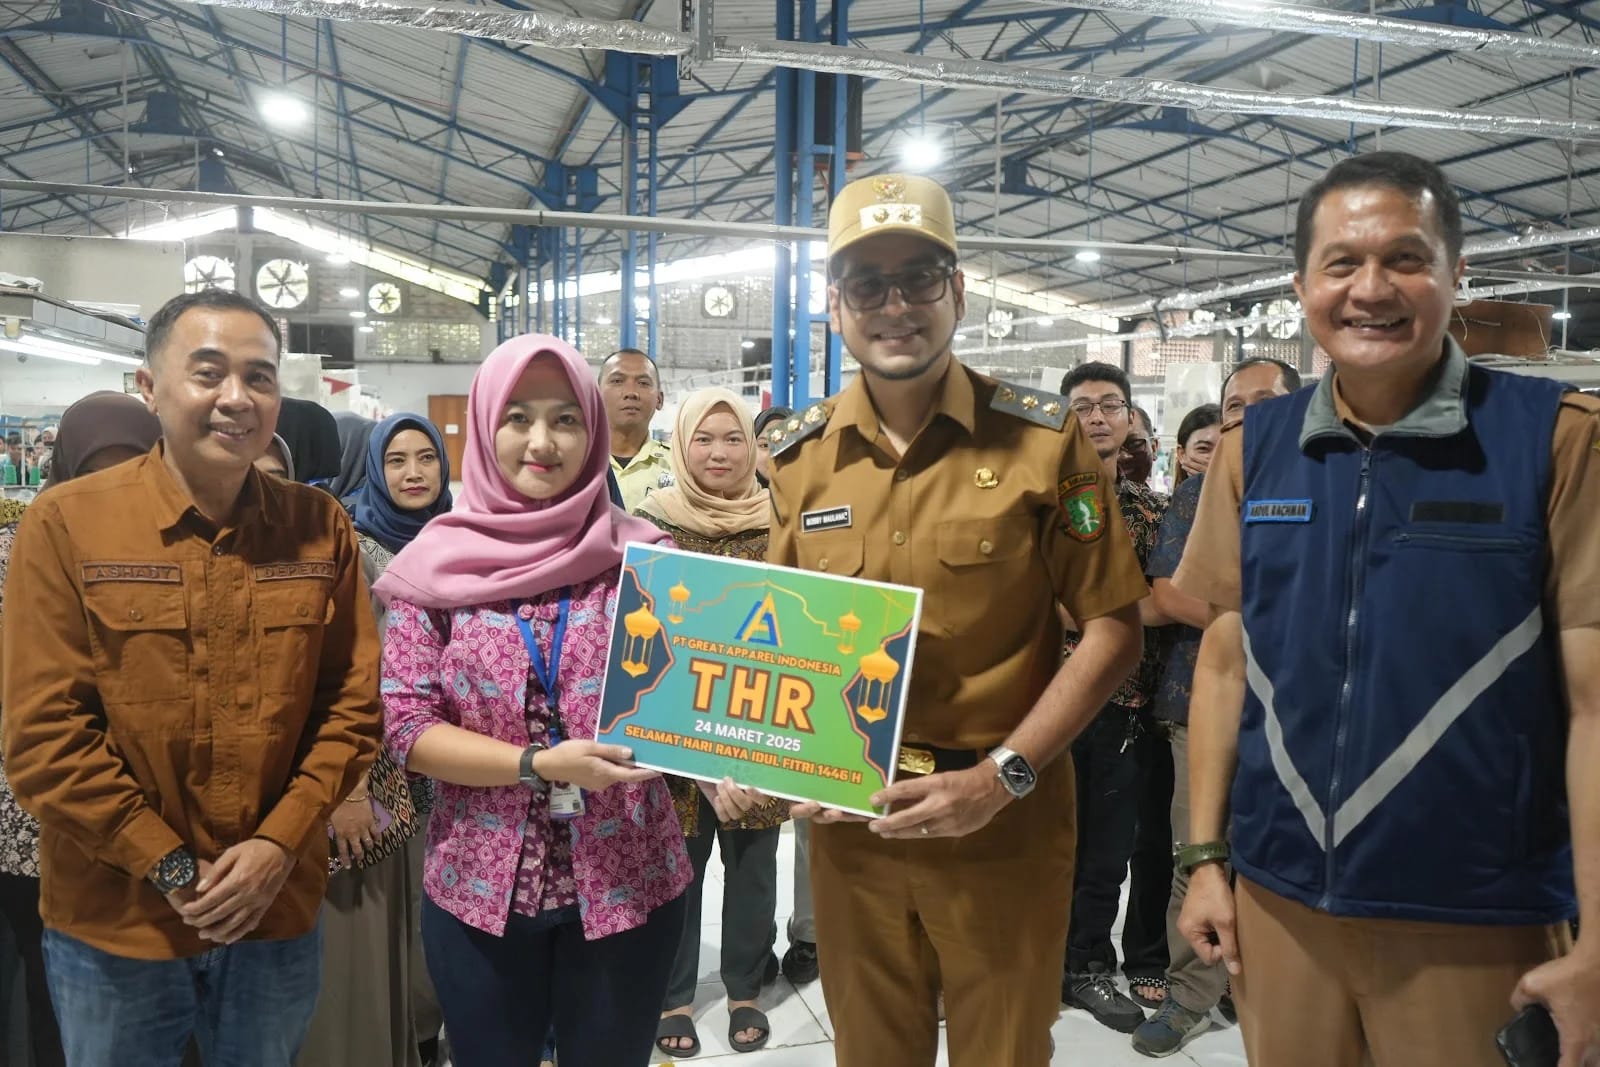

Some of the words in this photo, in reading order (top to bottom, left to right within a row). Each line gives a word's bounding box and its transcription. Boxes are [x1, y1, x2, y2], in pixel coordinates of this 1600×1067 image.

[672, 636, 688, 647] PT
[688, 638, 725, 654] GREAT
[726, 645, 775, 664] APPAREL
[777, 654, 842, 676] INDONESIA
[688, 657, 815, 735] THR
[624, 724, 681, 746] SELAMAT
[682, 736, 713, 753] HARI
[714, 743, 749, 761] RAYA
[751, 749, 780, 767] IDUL
[781, 756, 816, 775] FITRI
[817, 763, 850, 781] 1446
[850, 771, 863, 784] H
[694, 719, 712, 733] 24
[715, 723, 764, 744] MARET
[766, 734, 801, 752] 2025
